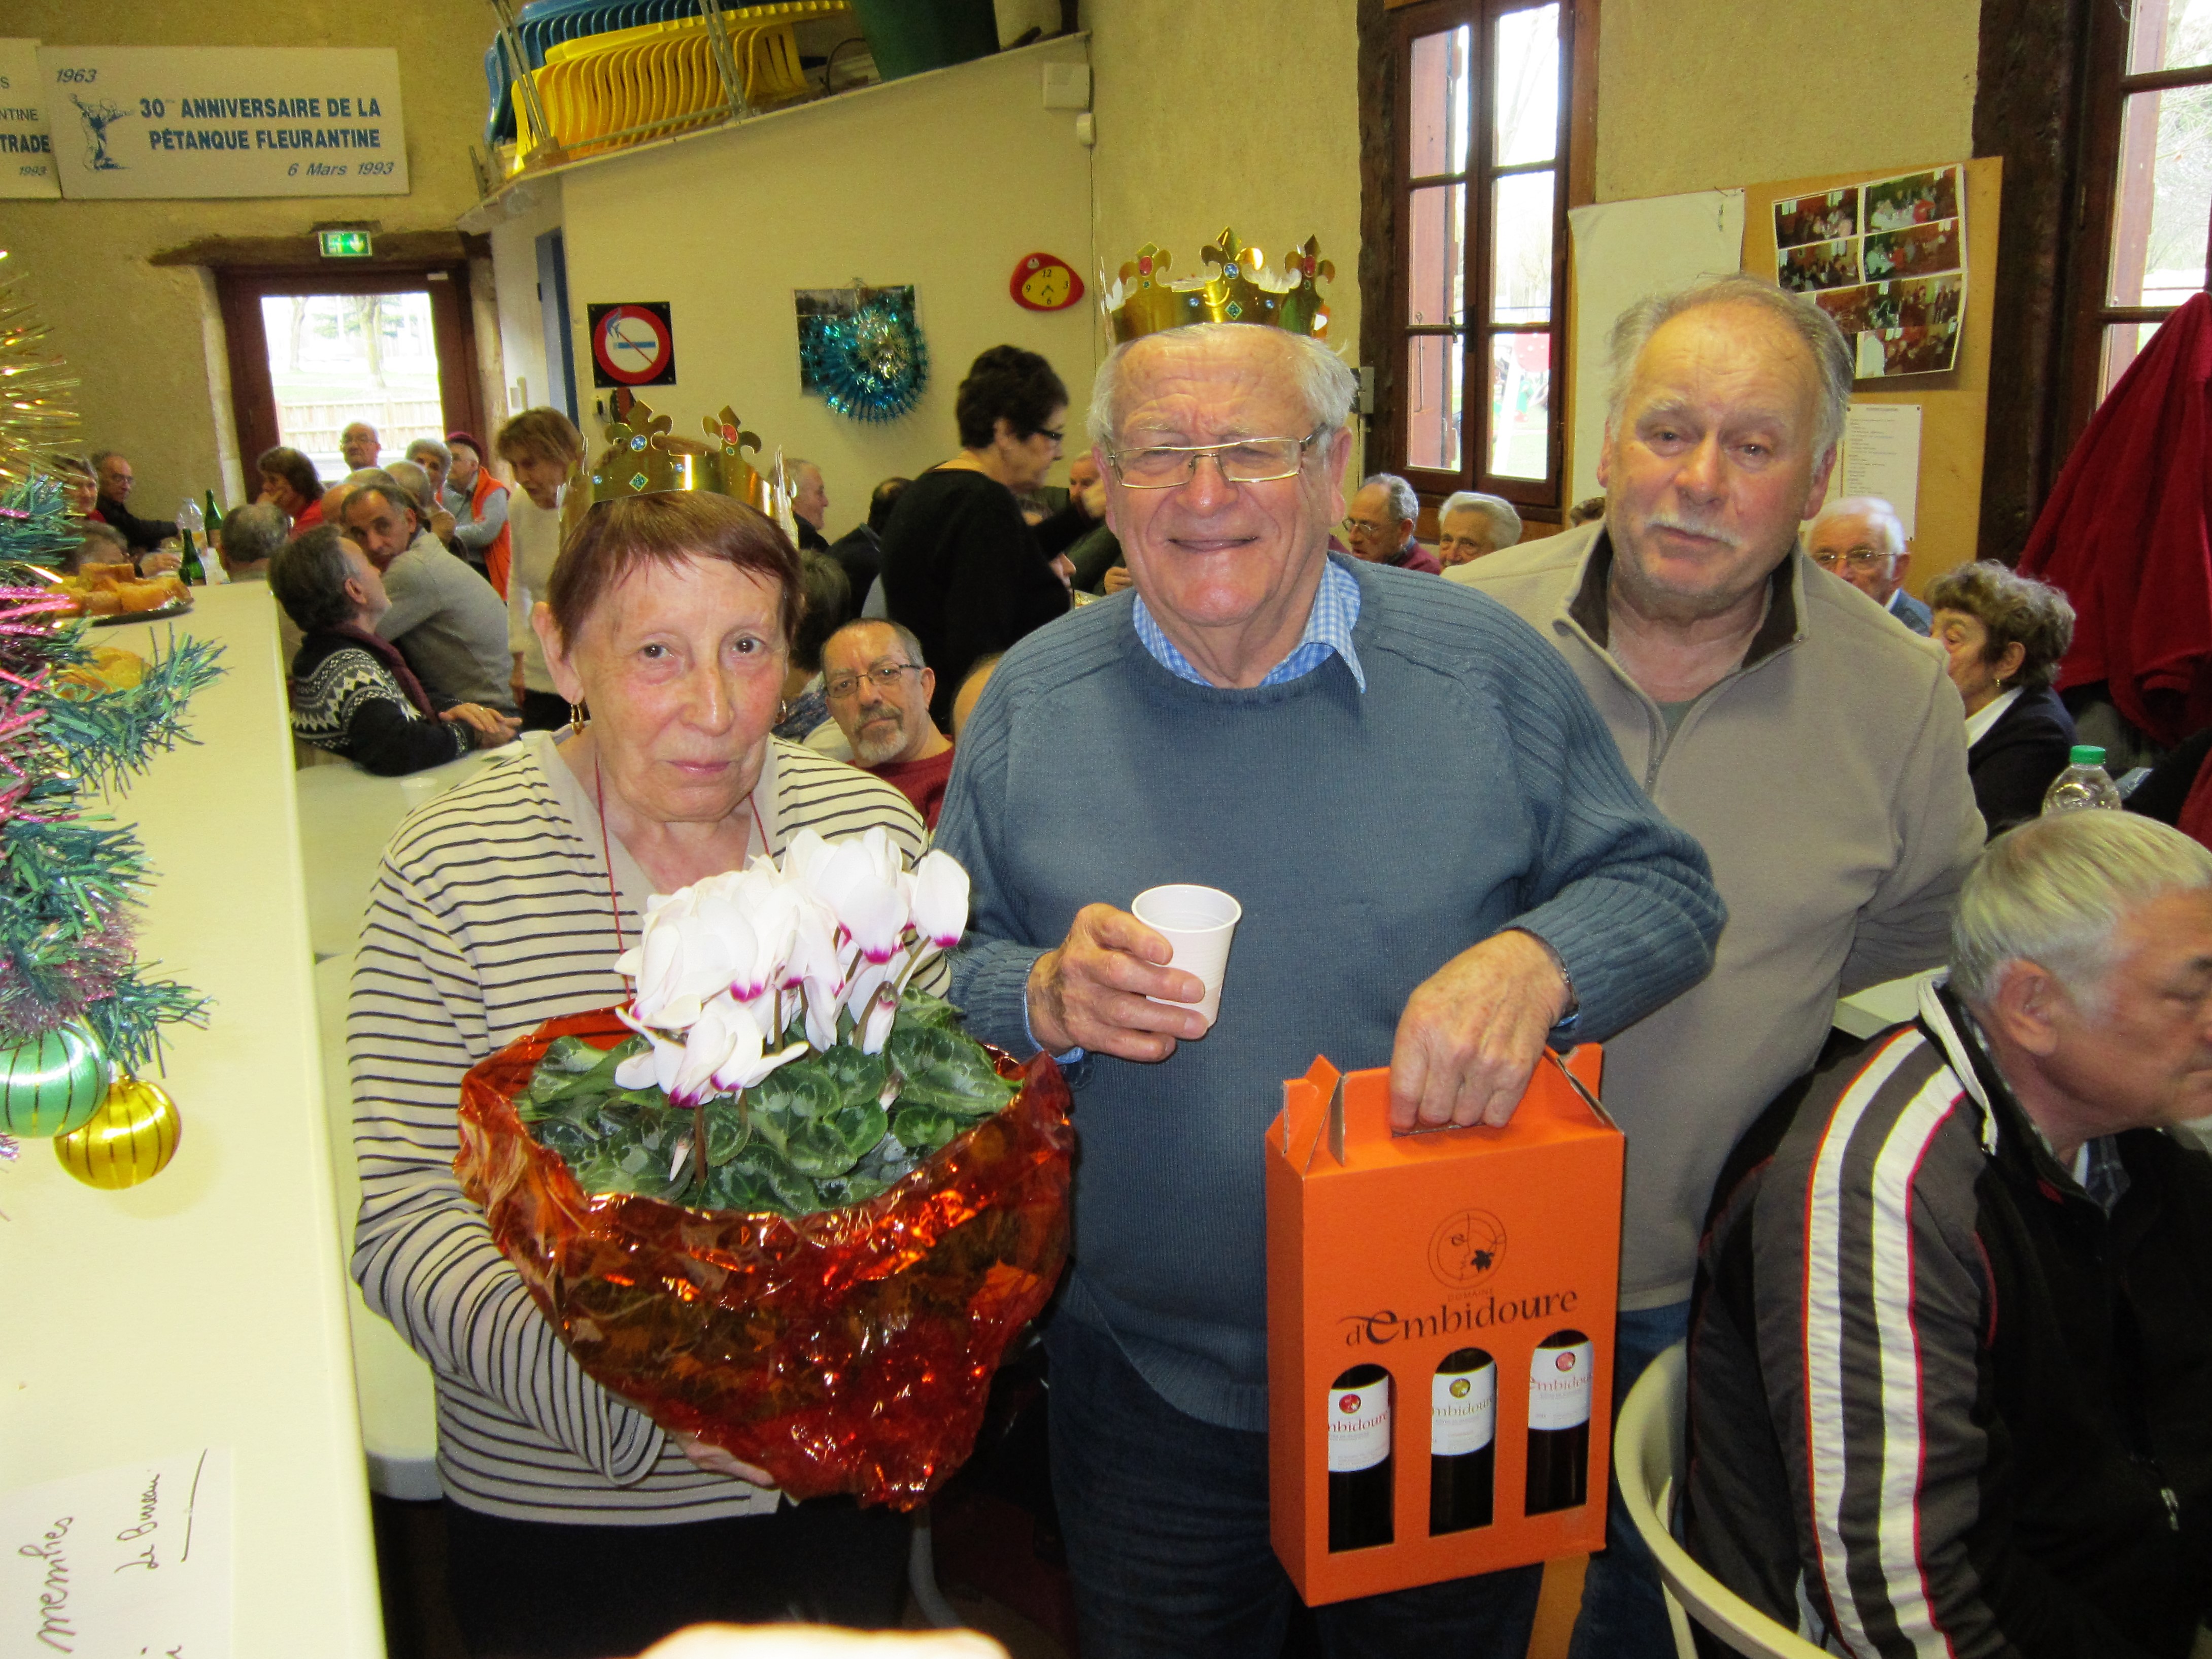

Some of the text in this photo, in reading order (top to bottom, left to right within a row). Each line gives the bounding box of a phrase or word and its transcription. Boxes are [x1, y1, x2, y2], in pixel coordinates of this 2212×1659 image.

[57, 69, 97, 83] 1963
[181, 97, 321, 118] ANNIVERSAIRE
[326, 97, 352, 117] DE
[357, 97, 381, 117] LA
[149, 127, 381, 150] PÉTANQUE FLEURANTINE
[287, 161, 394, 176] 6 Mars 1993
[1043, 269, 1052, 278] 12
[1047, 297, 1052, 305] 6
